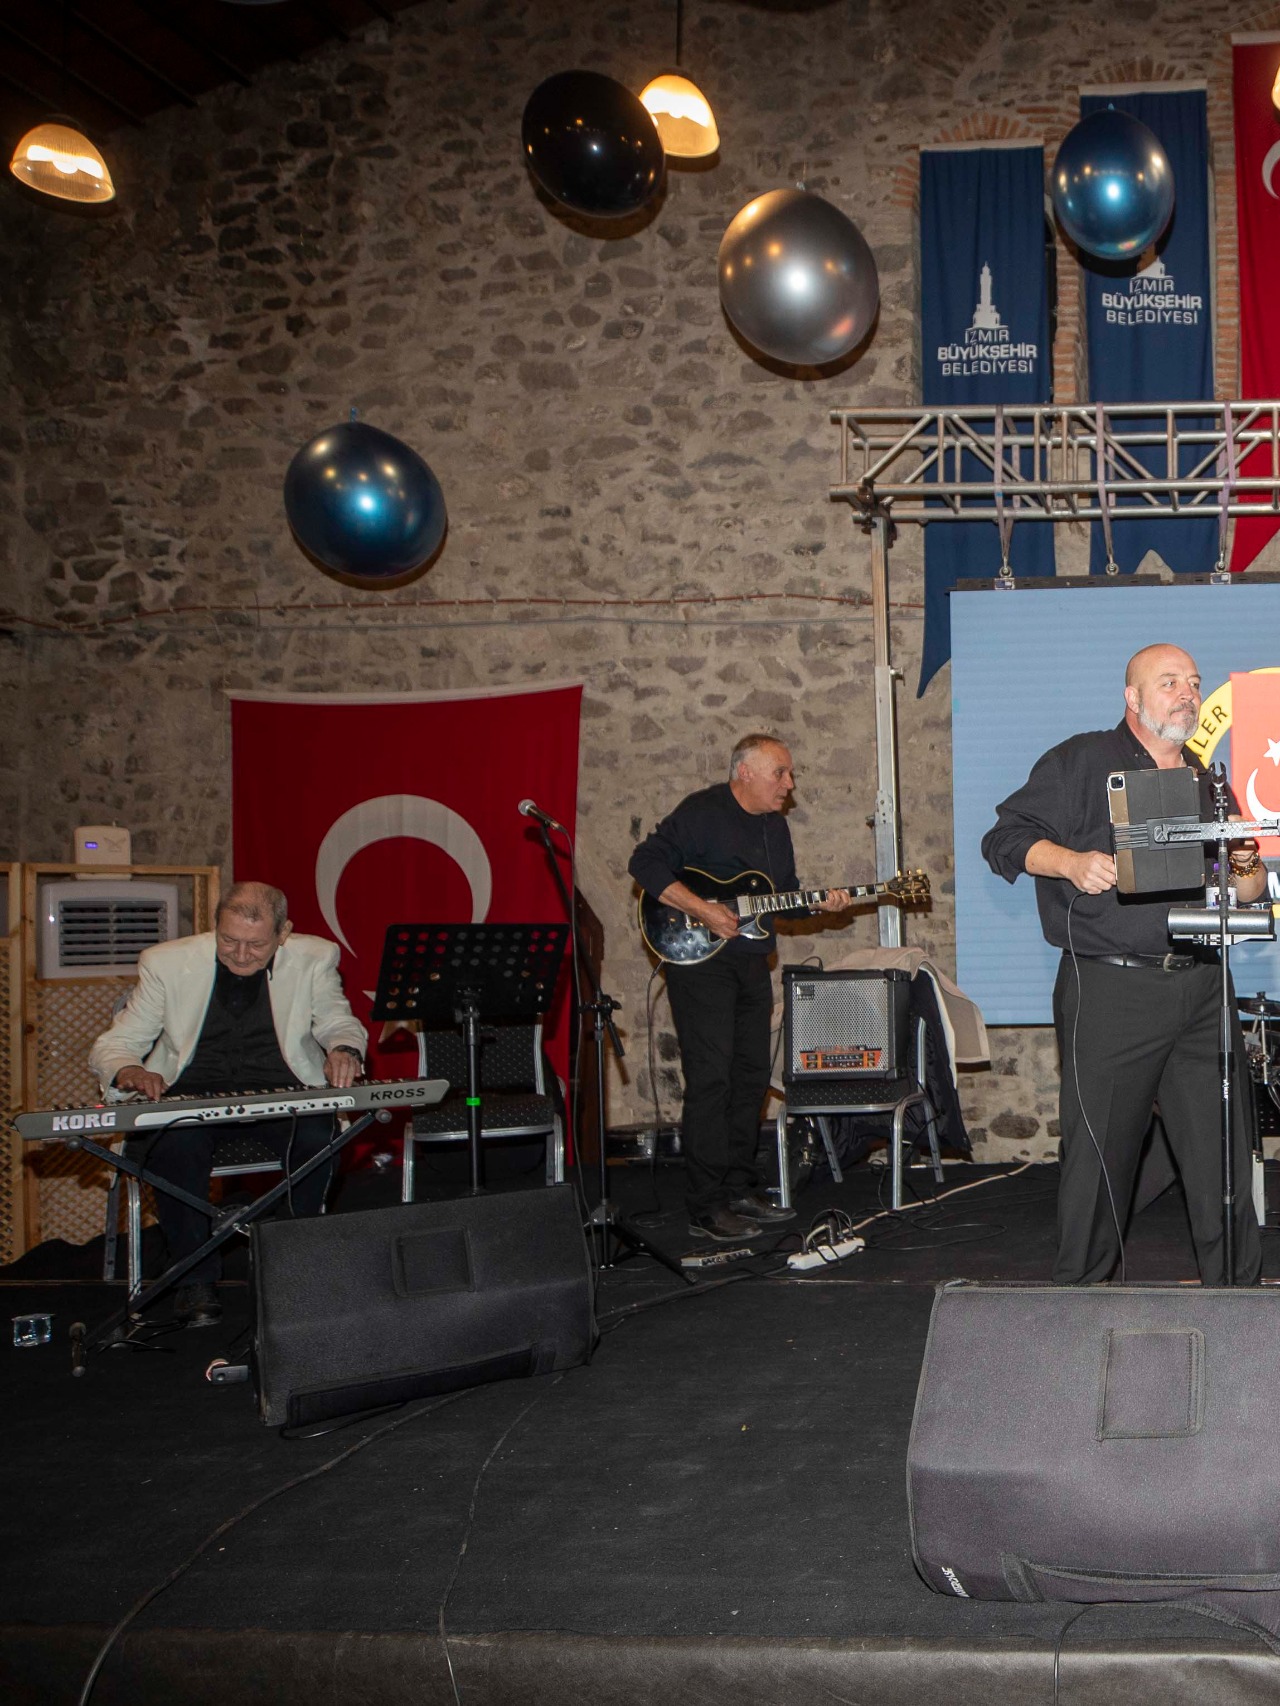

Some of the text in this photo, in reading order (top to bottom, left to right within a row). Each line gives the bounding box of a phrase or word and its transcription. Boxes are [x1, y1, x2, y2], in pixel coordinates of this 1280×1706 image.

[1129, 277, 1175, 294] İZMİR
[1102, 291, 1202, 311] BÜYÜKŞEHİR
[1106, 307, 1198, 326] BELEDİYESİ
[964, 328, 1010, 344] İZMİR
[937, 341, 1037, 361] BÜYÜKŞEHİR
[942, 358, 1033, 376] BELEDİYESİ
[1193, 705, 1228, 758] LER
[370, 1087, 425, 1102] KROSS
[52, 1111, 116, 1131] KORG
